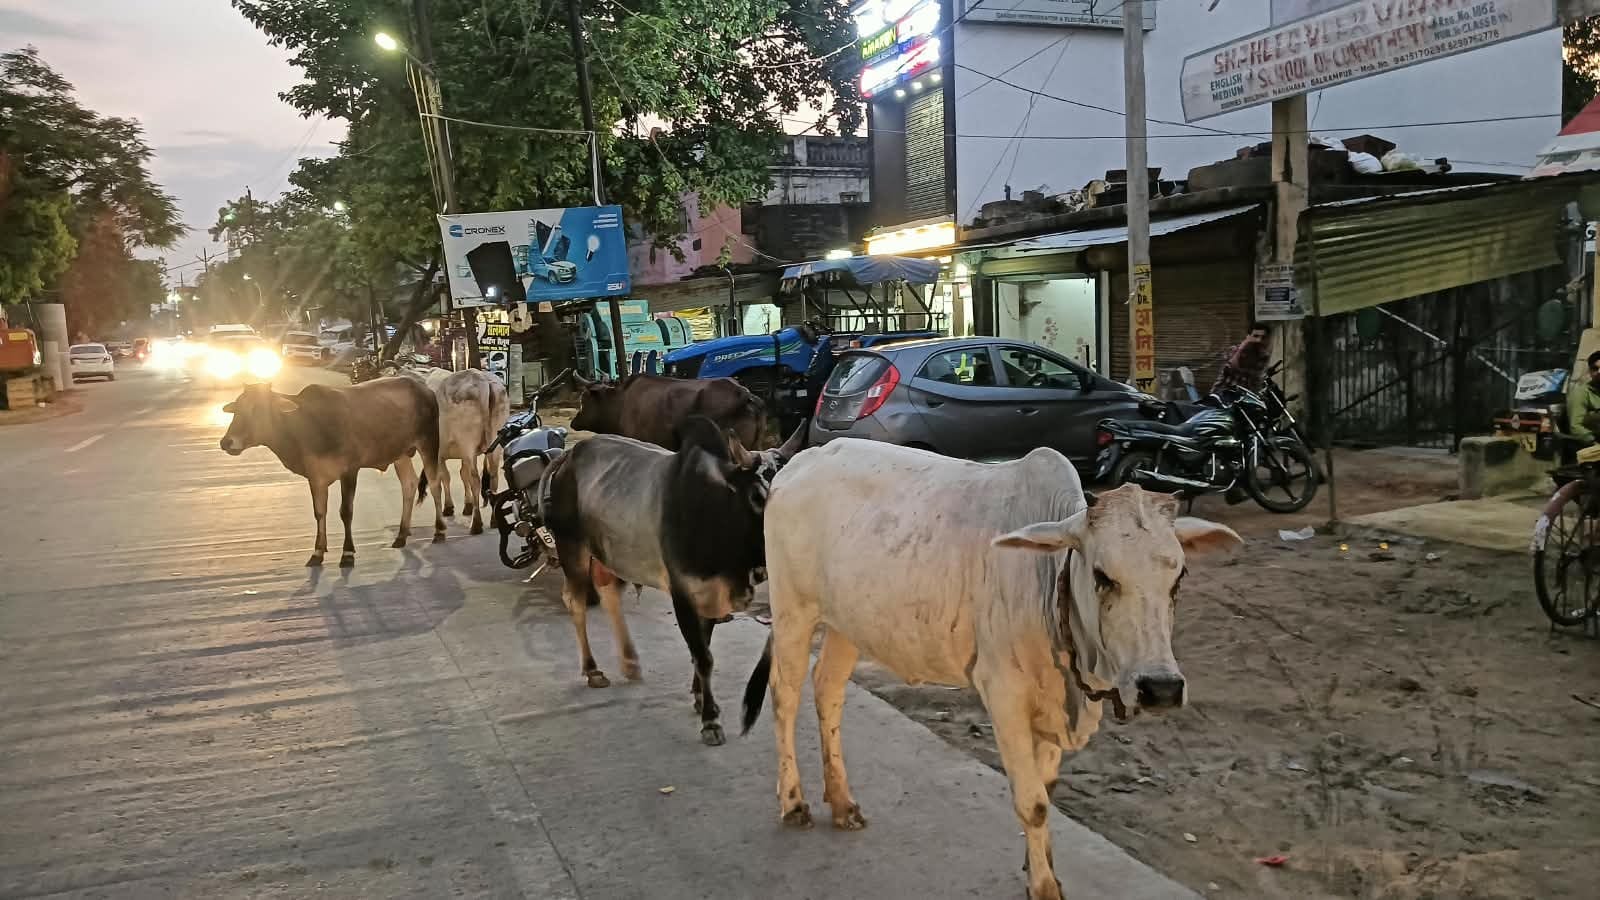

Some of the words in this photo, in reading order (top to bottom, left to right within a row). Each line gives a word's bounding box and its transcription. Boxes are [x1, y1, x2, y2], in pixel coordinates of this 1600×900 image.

[1462, 17, 1489, 33] CLASS
[1210, 73, 1242, 91] ENGLISH
[1212, 85, 1244, 102] MEDIUM
[464, 226, 506, 235] CRONEX
